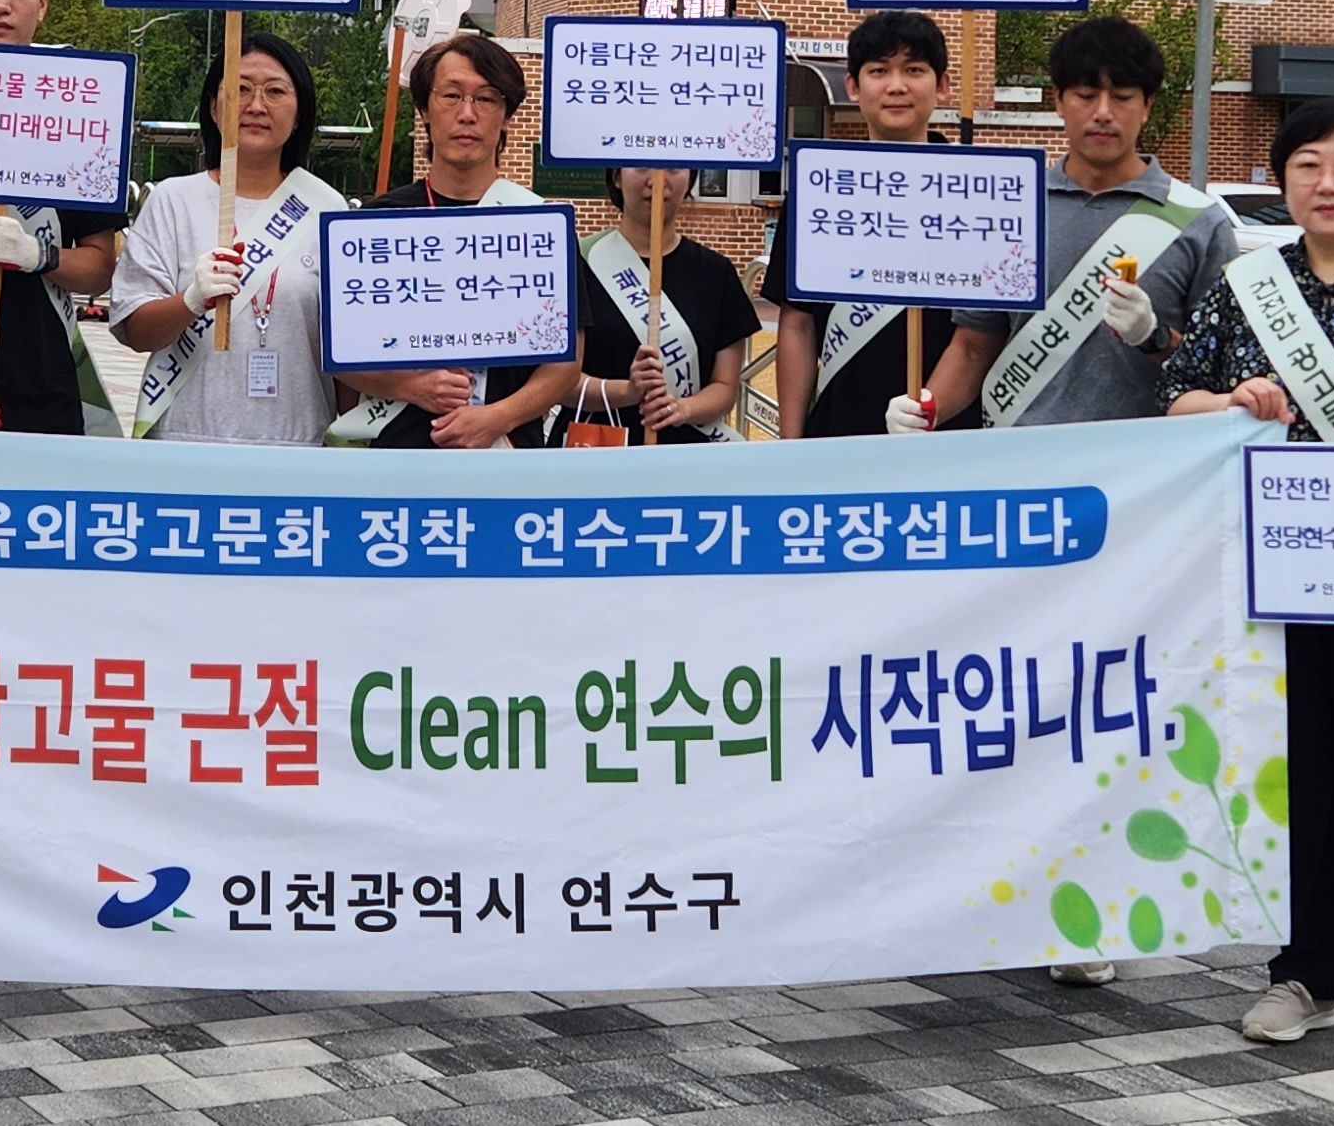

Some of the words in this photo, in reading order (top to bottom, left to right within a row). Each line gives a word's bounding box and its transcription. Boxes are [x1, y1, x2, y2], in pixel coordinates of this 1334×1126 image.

[564, 42, 660, 67] 아름다운
[670, 43, 766, 69] 거리미관
[34, 75, 101, 104] 추방은
[563, 79, 660, 105] 웃음짓는
[670, 81, 765, 107] 연수구민
[0, 113, 110, 144] 미래입니다
[623, 135, 678, 148] 인천광역시
[683, 135, 726, 149] 연수구청
[20, 173, 66, 187] 연수구청
[809, 168, 909, 197] 아름다운
[920, 173, 1024, 202] 거리미관
[265, 193, 310, 241] 불법
[809, 208, 909, 238] 웃음짓는
[920, 214, 1023, 242] 연수구민
[341, 235, 444, 264] 아름다운
[455, 232, 555, 260] 거리미관
[342, 277, 445, 305] 웃음짓는
[455, 272, 555, 301] 연수구민
[872, 269, 930, 284] 인천광역시
[935, 273, 982, 287] 연수구청
[1249, 276, 1300, 341] 건전한
[409, 333, 467, 348] 인천광역시
[472, 331, 516, 346] 연수구청
[142, 353, 182, 406] 거리
[989, 317, 1070, 413] 광고문화
[1261, 476, 1331, 501] 안전한
[358, 508, 475, 567] 정착
[514, 502, 750, 568] 연수구가
[780, 497, 1079, 563] 앞장섭니다.
[181, 659, 319, 786] 근절
[350, 666, 548, 771] Clean
[575, 656, 783, 785] 연수의
[811, 634, 1176, 779] 시작입니다.
[222, 870, 526, 934] 인천광역시
[561, 871, 741, 934] 연수구
